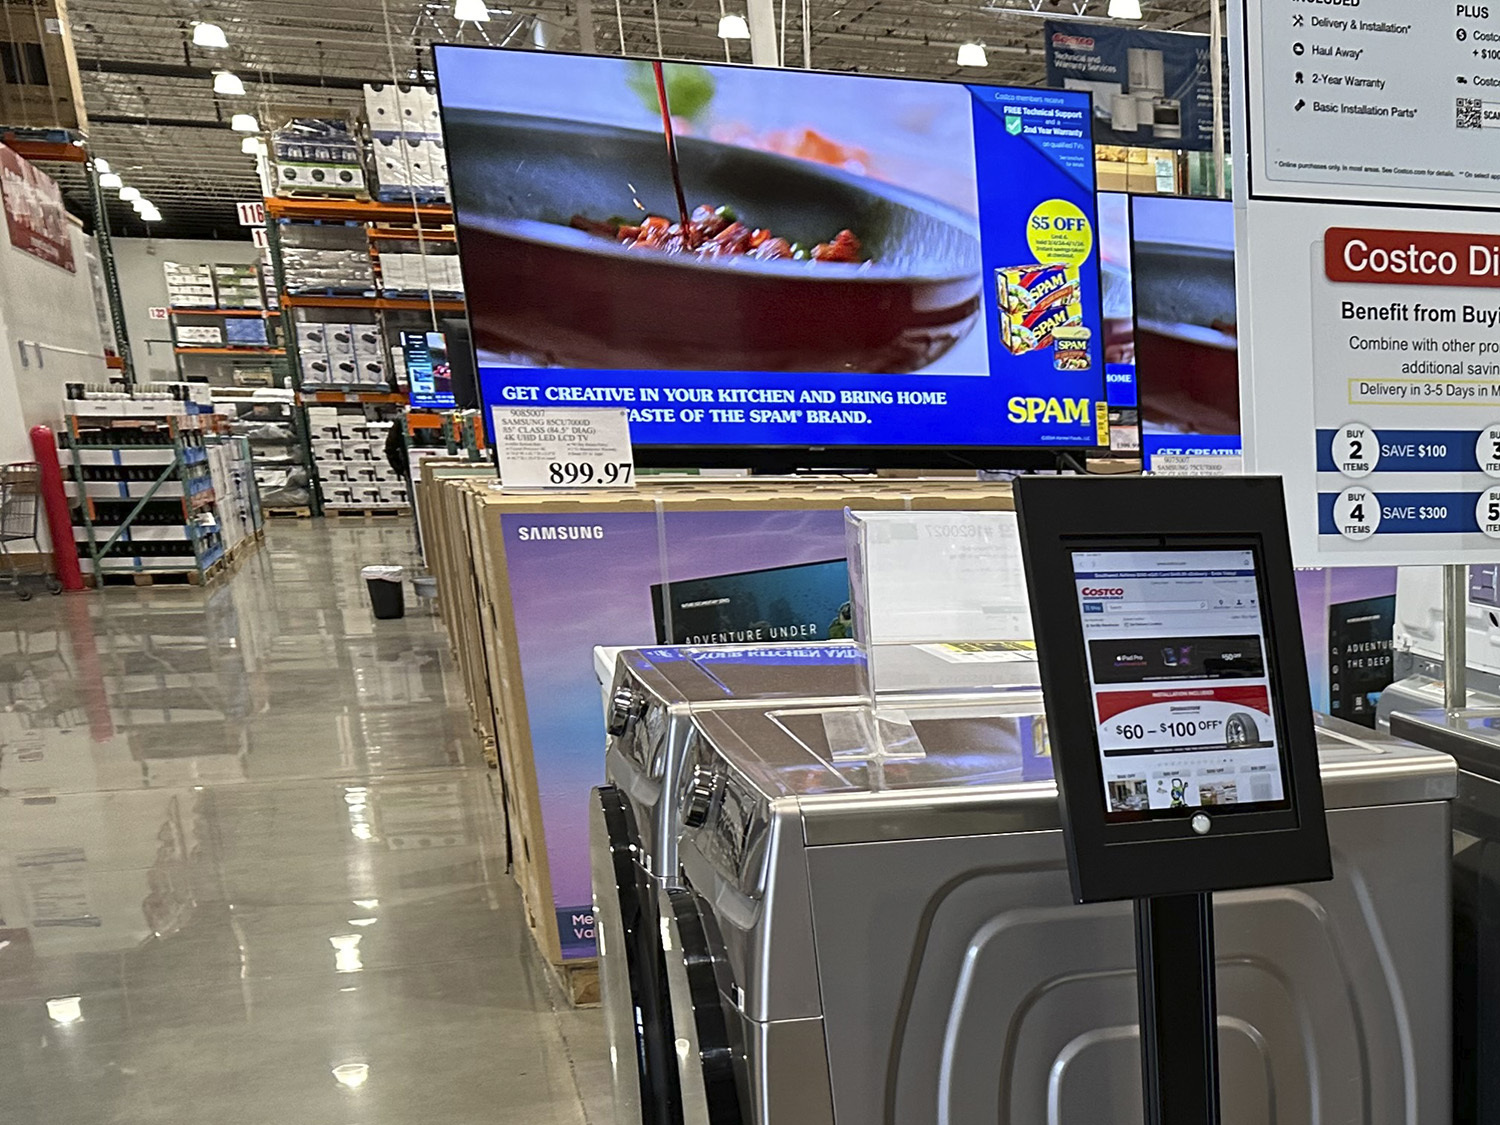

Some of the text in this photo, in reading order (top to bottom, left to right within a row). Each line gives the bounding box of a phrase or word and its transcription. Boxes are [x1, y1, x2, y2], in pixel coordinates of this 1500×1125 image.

[1456, 5, 1489, 19] PLUS
[1311, 16, 1348, 31] Delivery
[1312, 45, 1333, 57] Haul
[1312, 73, 1386, 91] 2-Year Warranty
[1003, 105, 1083, 119] FREE Technical Support
[1313, 101, 1389, 117] Basic Installation
[1023, 125, 1083, 138] 2nd Year Warranty
[240, 204, 265, 224] 116
[1031, 215, 1086, 232] $5 OFF
[1343, 239, 1457, 275] Costco
[1030, 272, 1064, 301] SPAM
[1341, 301, 1409, 322] Benefit
[1413, 304, 1456, 323] from
[1033, 309, 1067, 340] SPAM
[1058, 339, 1087, 350] SPAM
[1349, 336, 1408, 352] Combine
[1411, 337, 1439, 352] with
[1441, 338, 1476, 353] other
[1401, 360, 1464, 376] additional
[501, 386, 948, 406] GET CREATIVE IN YOUR KITCHEN AND BRING HOME
[1359, 382, 1407, 398] Delivery
[1410, 383, 1421, 396] in
[1424, 383, 1443, 397] 3-5
[1446, 383, 1476, 399] Days
[1477, 384, 1489, 397] in
[510, 408, 546, 417] 9085007
[679, 408, 706, 423] OF
[711, 409, 746, 424] THE
[806, 409, 872, 425] BRAND.
[1007, 396, 1090, 425] SPAM
[501, 418, 545, 426] SAMSUNG
[517, 426, 597, 435] CLASS DIAG)
[1346, 430, 1365, 439] BUY
[1349, 440, 1363, 460] 2
[1381, 444, 1447, 458] SAVE $100
[549, 462, 633, 485] 899.97
[1342, 463, 1369, 472] ITEMS
[1347, 493, 1366, 502] BUY
[1349, 503, 1365, 523] 4
[1382, 506, 1448, 520] SAVE $300
[517, 525, 605, 542] SAMSUNG
[1344, 525, 1371, 534] ITEMS
[1081, 587, 1124, 596] COSTCO
[684, 623, 818, 645] ADVENTURE UNDER
[1347, 655, 1391, 669] THE DEEP
[1116, 724, 1144, 740] $60
[1159, 721, 1197, 738] $100
